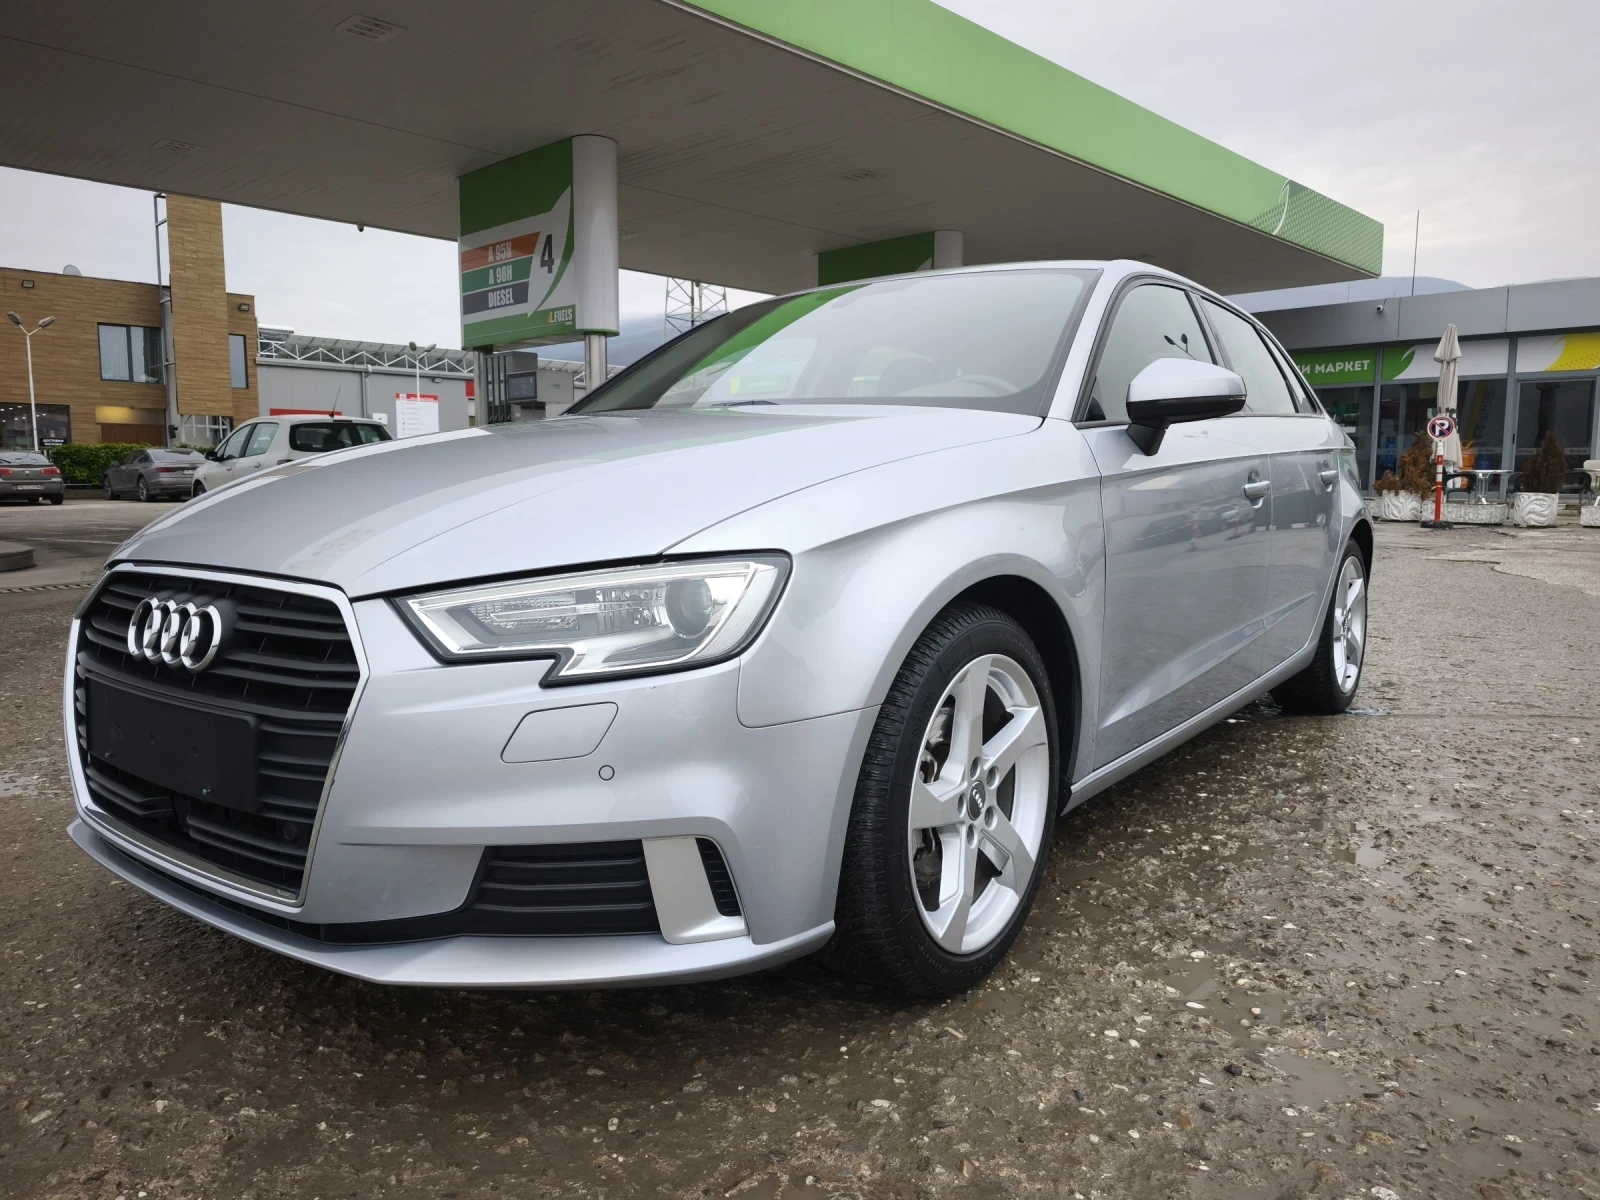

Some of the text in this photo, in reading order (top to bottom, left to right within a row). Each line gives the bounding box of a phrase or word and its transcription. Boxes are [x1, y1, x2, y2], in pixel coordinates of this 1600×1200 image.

[488, 246, 494, 263] A
[540, 233, 555, 274] 4
[489, 269, 495, 285] A
[488, 287, 514, 308] DIESEL
[1315, 359, 1370, 374] МАРКЕТ
